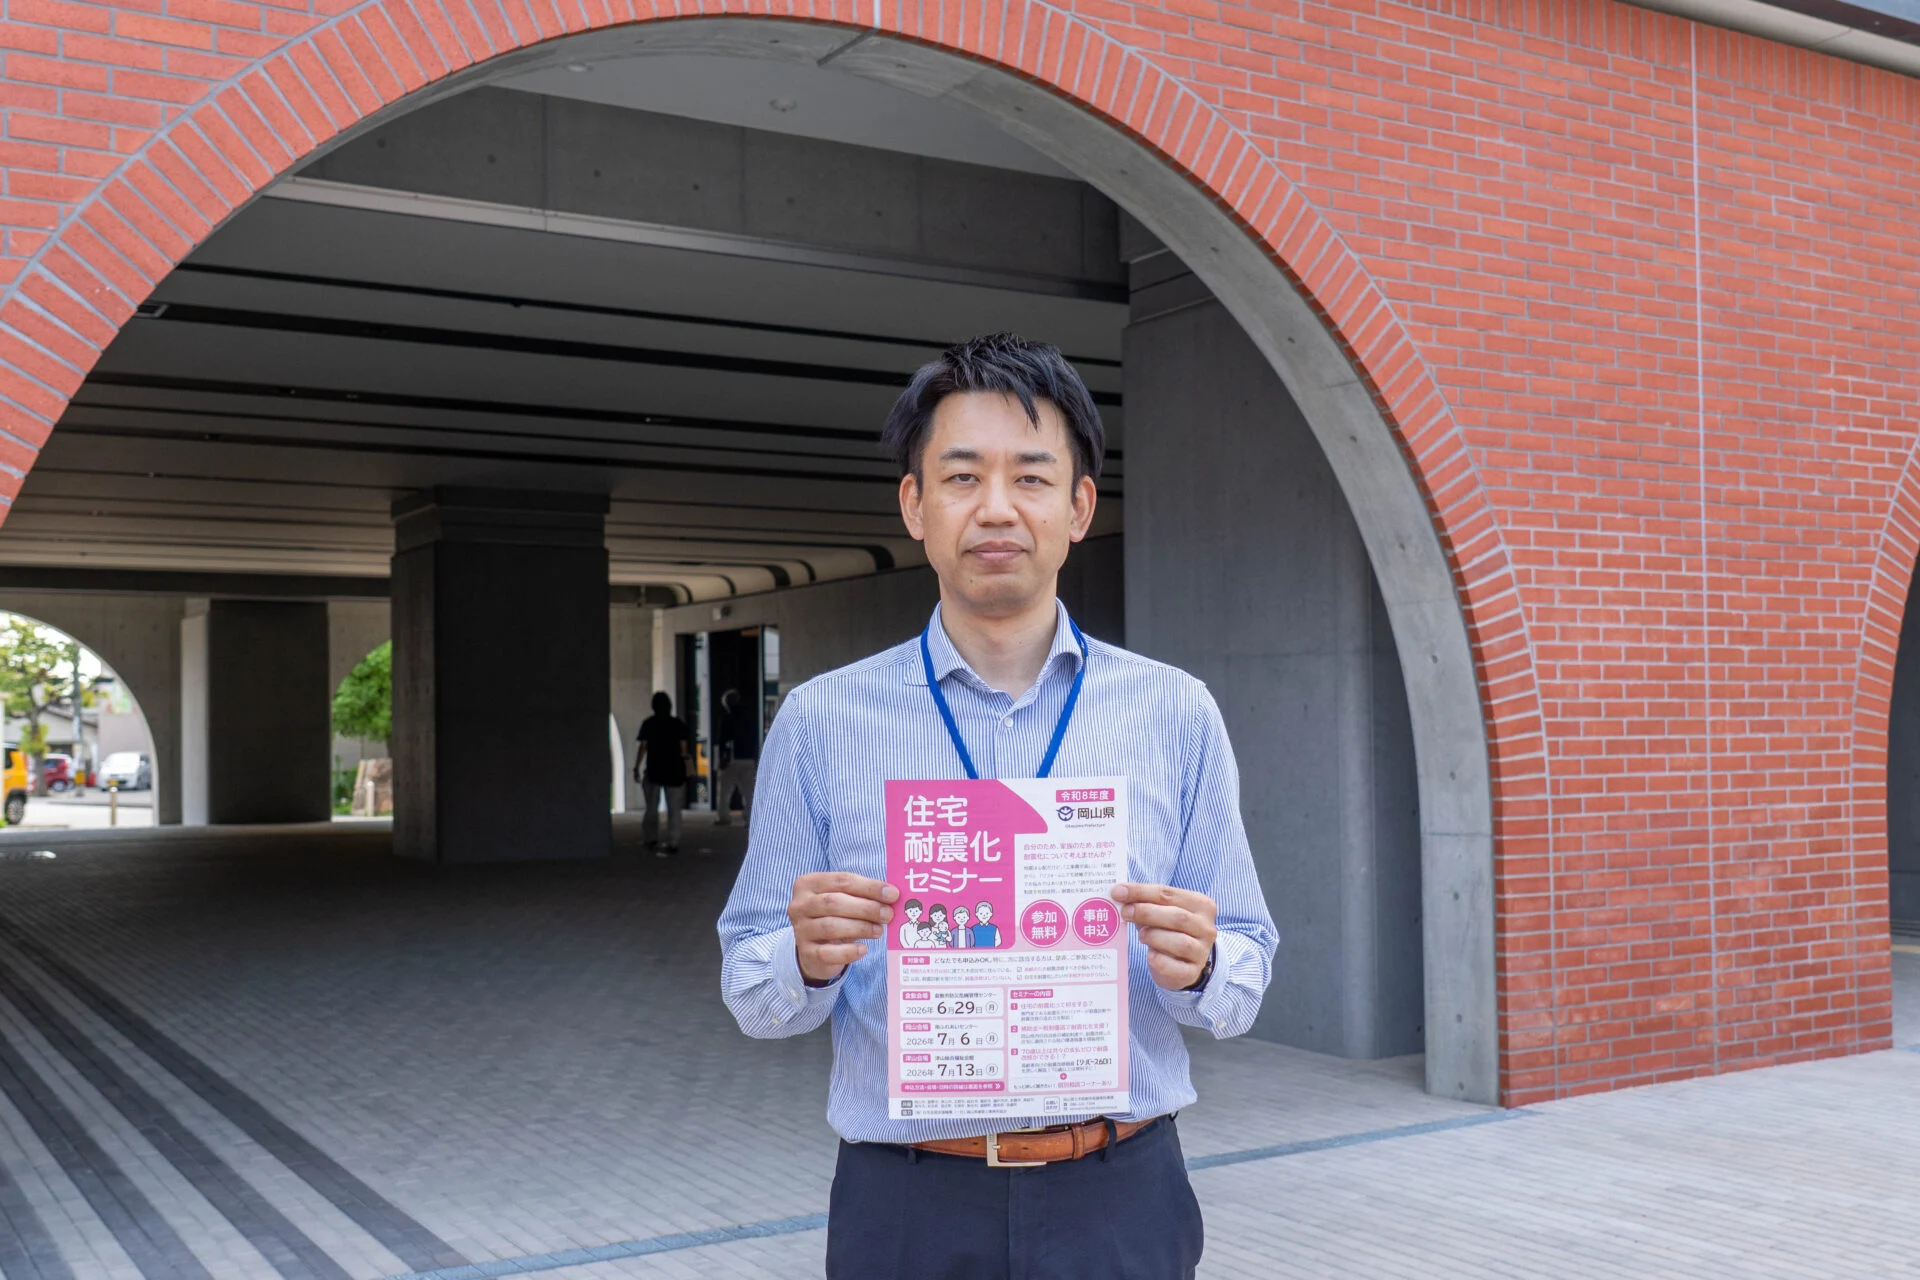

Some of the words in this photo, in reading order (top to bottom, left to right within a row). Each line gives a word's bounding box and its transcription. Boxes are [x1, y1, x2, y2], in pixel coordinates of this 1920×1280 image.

[1061, 790, 1109, 801] 令和8年度
[904, 795, 967, 827] 住宅
[1077, 807, 1115, 820] 岡山県
[904, 832, 1002, 863] 耐震化
[904, 868, 1003, 894] セミナー
[1031, 910, 1057, 925] 参加
[1083, 908, 1109, 923] 事前
[1031, 926, 1057, 940] 無料
[1083, 924, 1109, 938] 申込
[1013, 990, 1051, 998] セミナーの内容
[906, 1006, 934, 1014] 2026年
[906, 1037, 934, 1046] 2026年
[906, 1069, 934, 1077] 2026年
